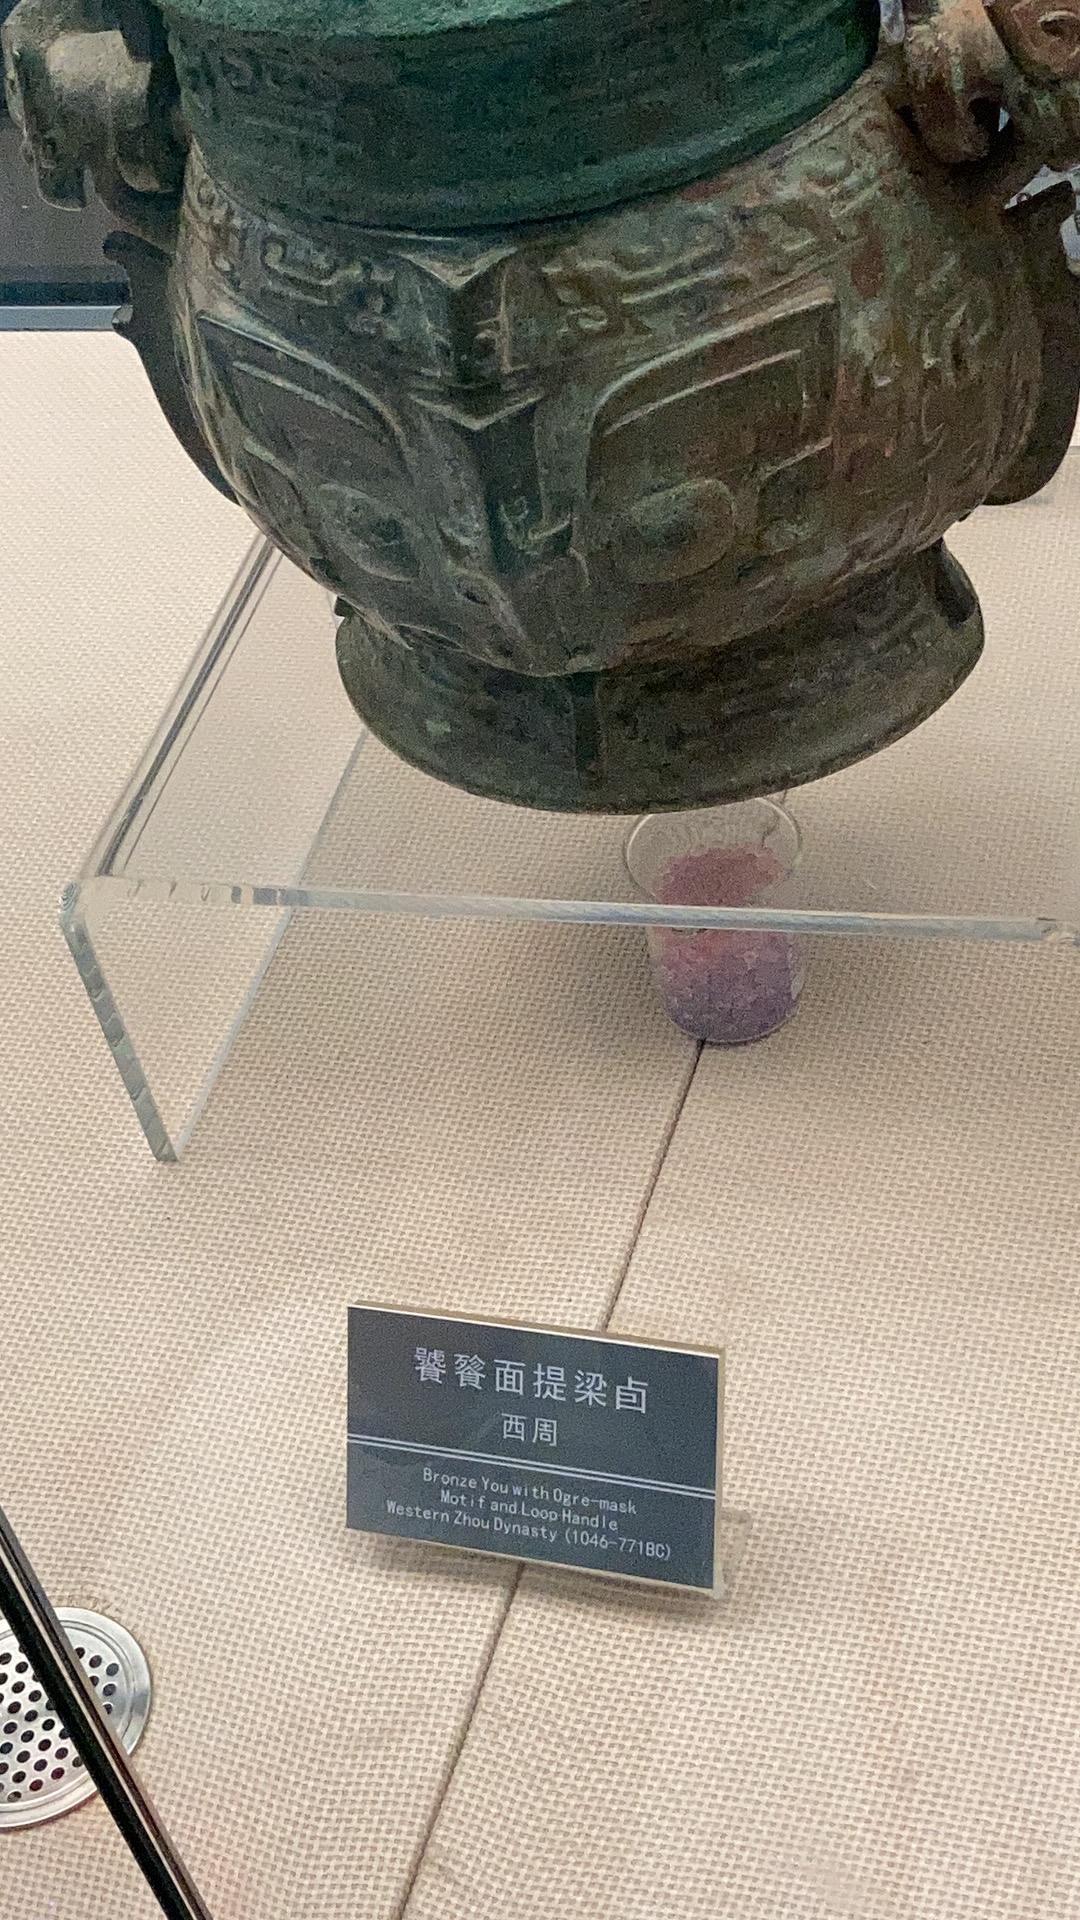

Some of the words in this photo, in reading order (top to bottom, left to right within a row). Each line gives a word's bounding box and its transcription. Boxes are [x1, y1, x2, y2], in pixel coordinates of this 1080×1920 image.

[414, 1346, 649, 1414] 饕餮面提梁卣
[501, 1412, 558, 1447] 西周
[423, 1467, 477, 1489] Bronze
[481, 1476, 508, 1495] You
[512, 1483, 549, 1501] with
[553, 1488, 637, 1515] Ogre-mask
[440, 1490, 486, 1509] Motif
[490, 1497, 518, 1515] and
[521, 1502, 558, 1522] Loop
[562, 1509, 618, 1531] Handle
[386, 1499, 450, 1523] Western
[453, 1511, 490, 1531] Zhou
[494, 1518, 557, 1543] Dynasty
[565, 1527, 672, 1560] (1046-771BC)
